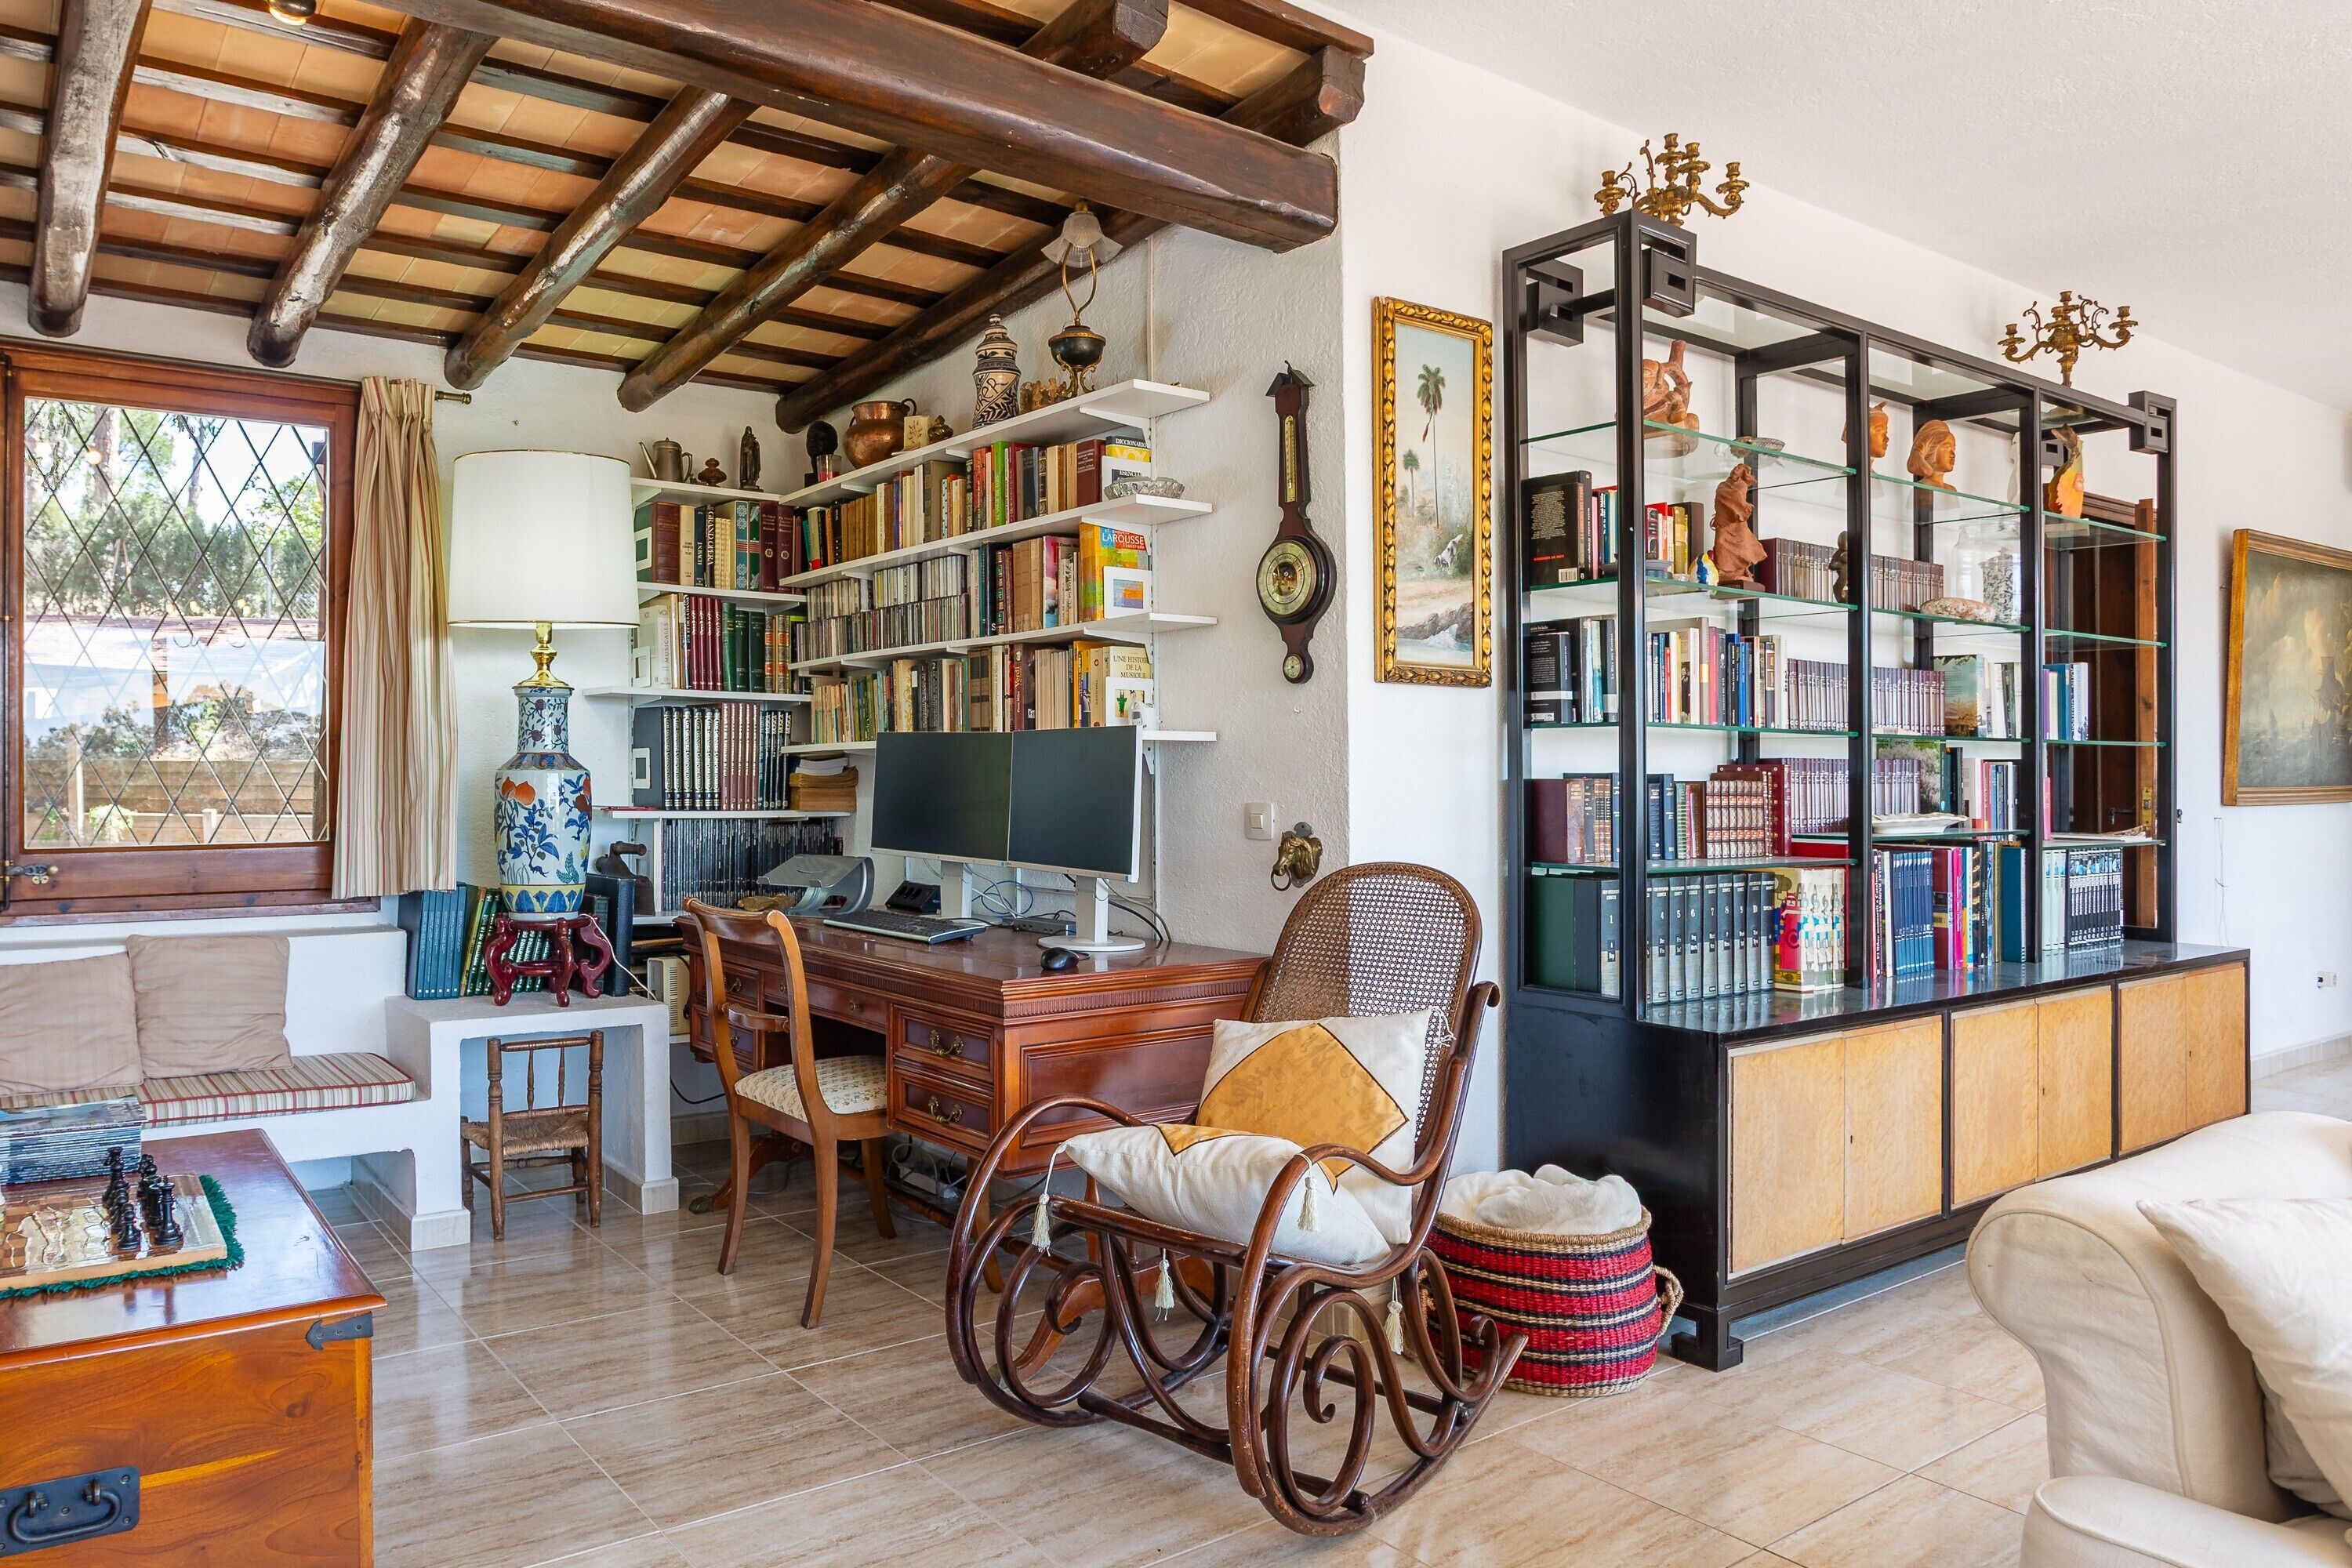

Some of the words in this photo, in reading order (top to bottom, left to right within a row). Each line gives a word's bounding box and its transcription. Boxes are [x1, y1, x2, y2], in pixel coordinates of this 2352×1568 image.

[1116, 438, 1147, 448] DICCIONARIO
[1102, 533, 1145, 545] LAROUSSE
[1676, 909, 1681, 918] 5
[1690, 909, 1696, 917] 6
[1710, 907, 1715, 916] 7
[1725, 906, 1730, 915] 8
[1609, 914, 1613, 924] 1
[1660, 911, 1664, 920] 4
